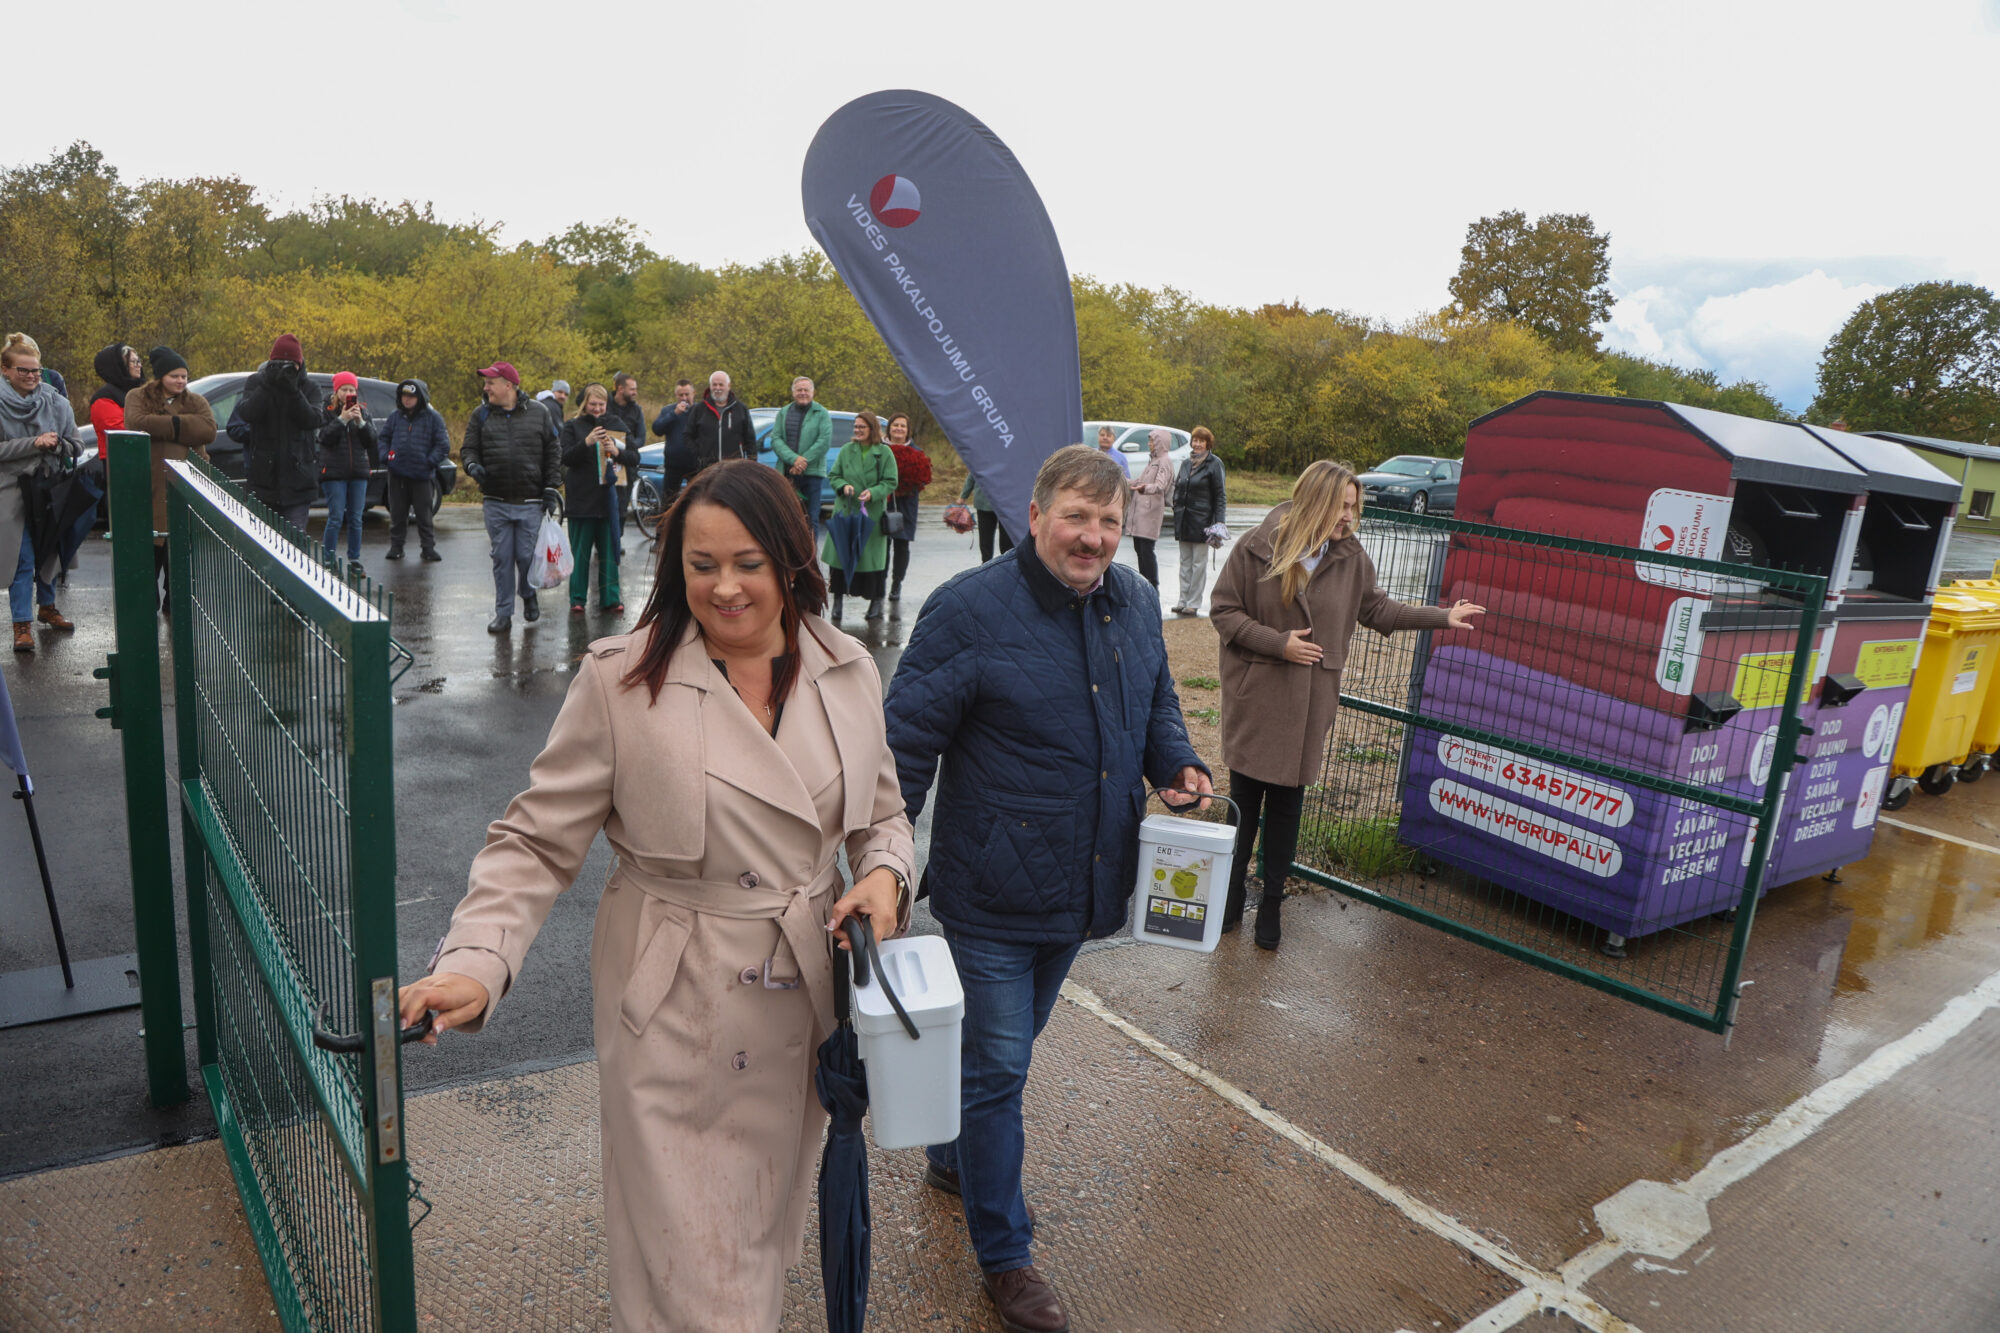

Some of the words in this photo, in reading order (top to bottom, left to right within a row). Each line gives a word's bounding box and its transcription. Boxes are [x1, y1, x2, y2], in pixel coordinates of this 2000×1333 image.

[847, 193, 888, 251] VIDES
[883, 252, 976, 382] PAKALPOJUMU
[971, 385, 1015, 448] GRUPA
[1677, 526, 1688, 555] VIDES
[1820, 720, 1842, 736] DOD
[1465, 748, 1497, 764] KLIENTU
[1690, 744, 1718, 764] DOD
[1815, 738, 1848, 758] JAUNU
[1463, 757, 1494, 772] CENTRS
[1810, 758, 1838, 779] DZĪVI
[1502, 763, 1623, 816] 63457777
[1805, 777, 1839, 800] SAVĀM
[1801, 796, 1845, 821] VECAJĀM
[1438, 788, 1613, 865] WWW.VPGRUPA.LV
[1794, 817, 1837, 842] DRĒBĒM!
[1157, 846, 1172, 855] EKO
[1669, 830, 1728, 861] VECAJĀM
[1661, 855, 1719, 885] DRĒBĒM!
[1153, 883, 1164, 891] 5L
